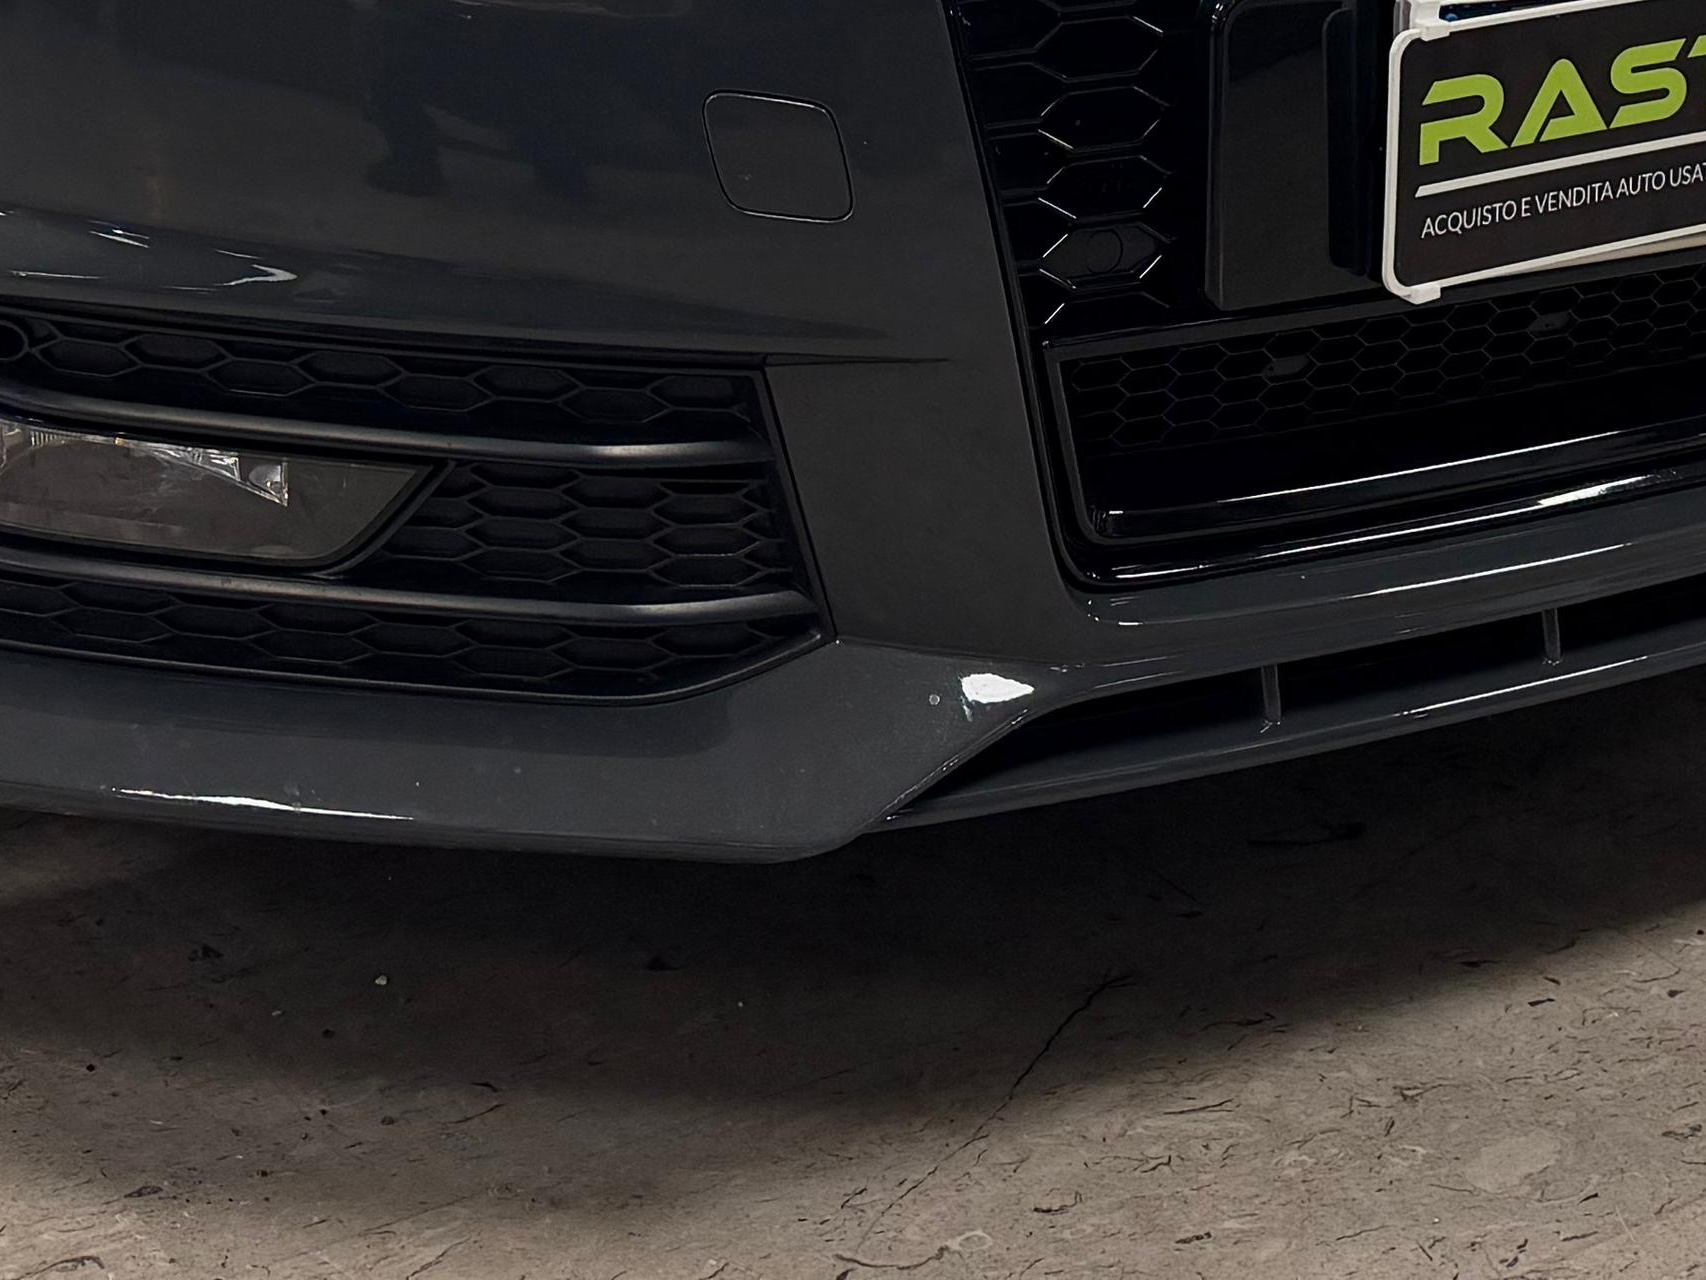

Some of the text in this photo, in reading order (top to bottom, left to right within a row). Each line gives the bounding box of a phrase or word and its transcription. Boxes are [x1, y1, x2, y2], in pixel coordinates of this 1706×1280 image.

[1420, 199, 1518, 240] ACQUISTO
[1521, 196, 1532, 218] E
[1534, 181, 1614, 215] VENDITA
[1616, 170, 1666, 199] AUTO
